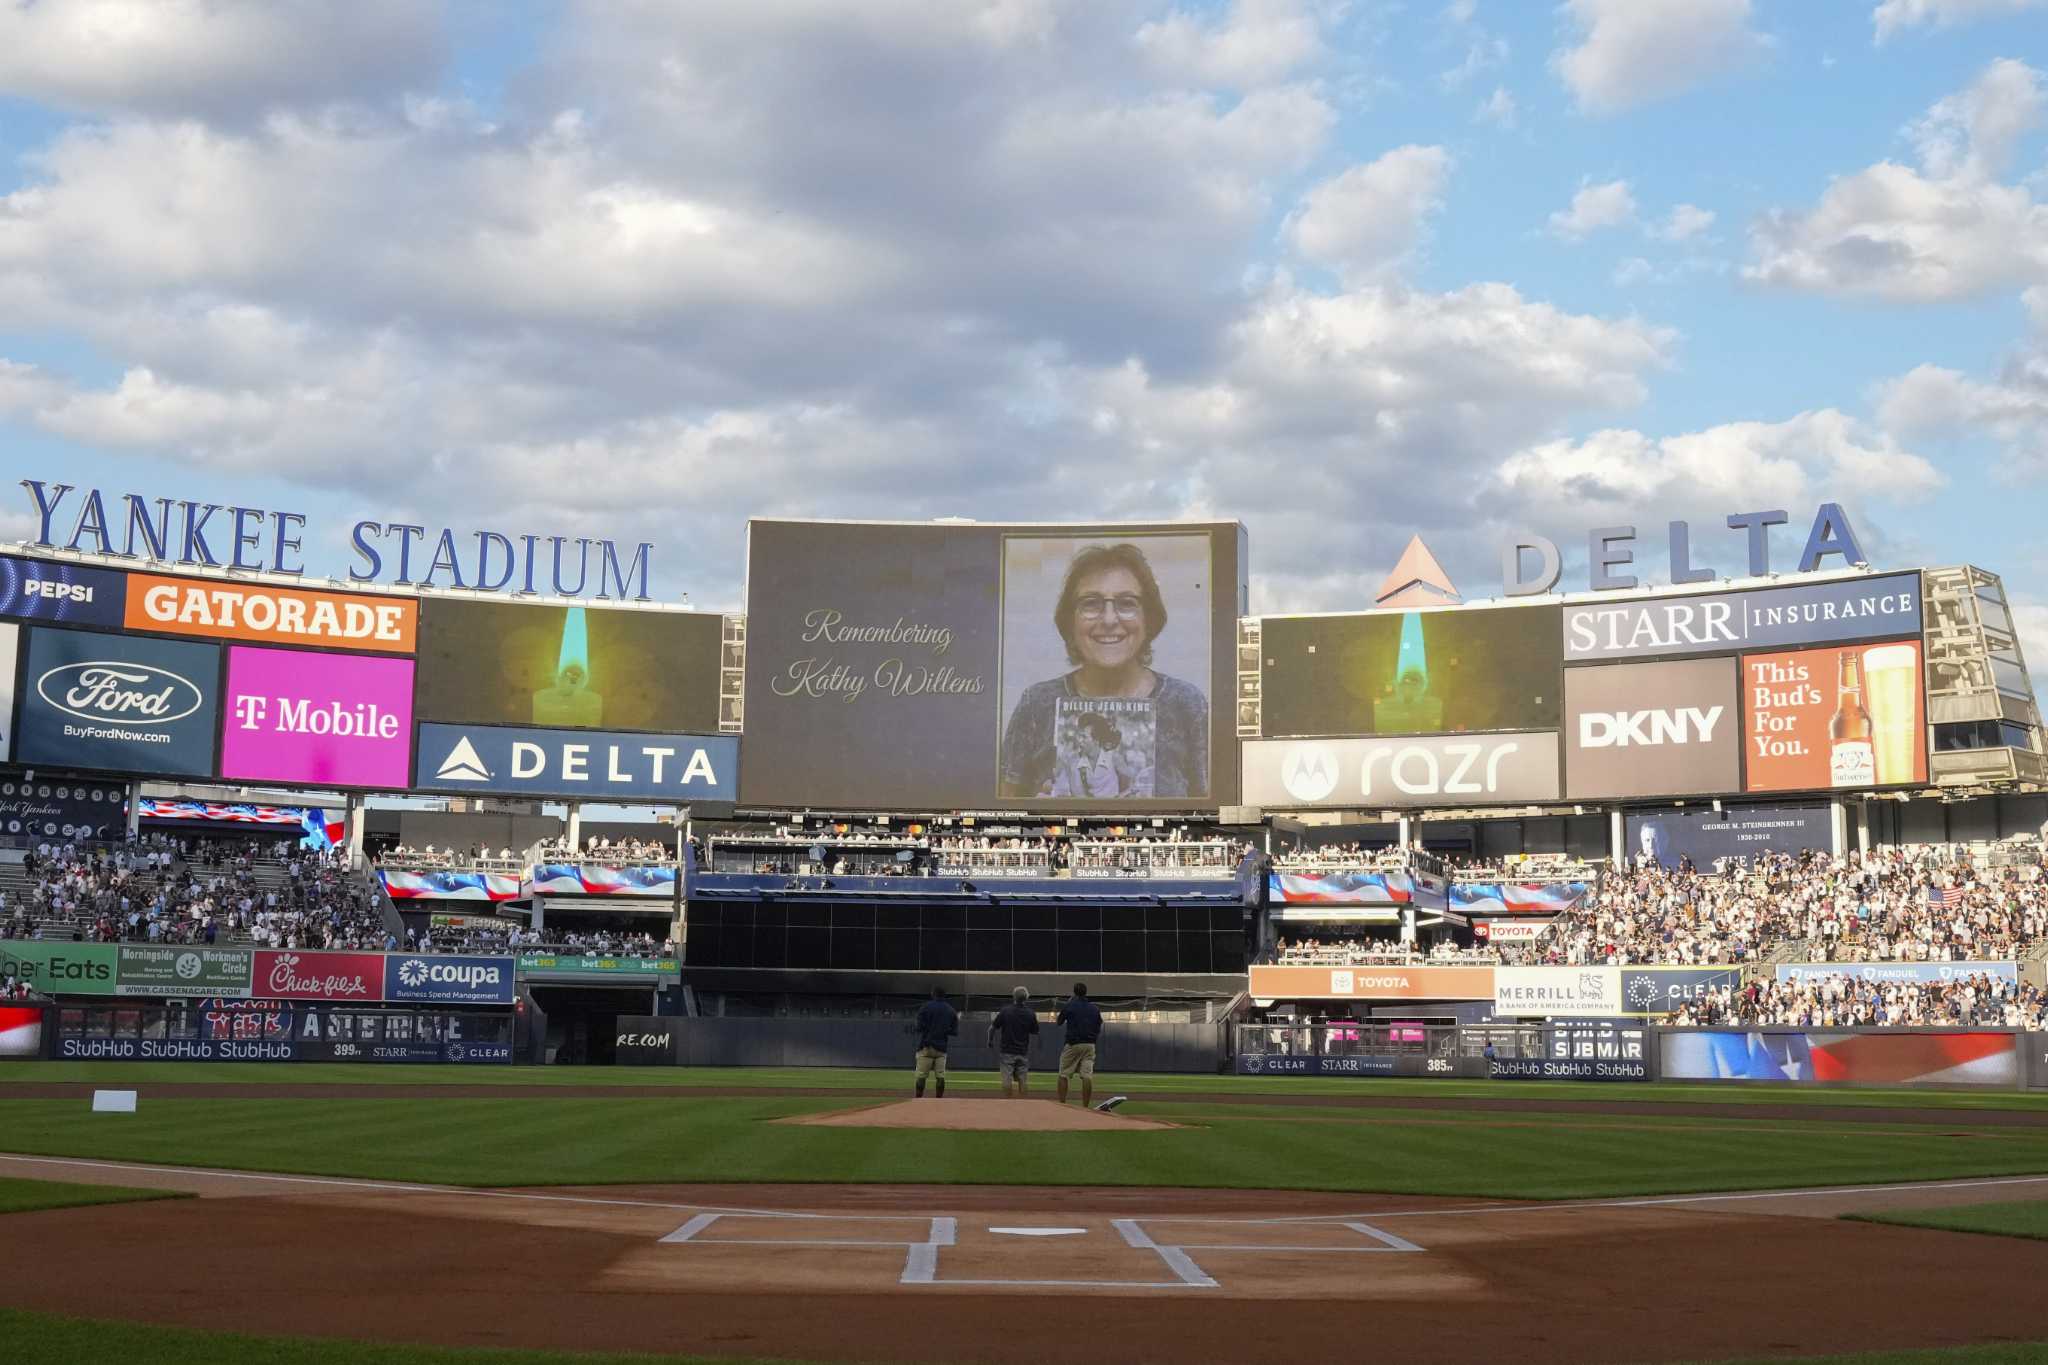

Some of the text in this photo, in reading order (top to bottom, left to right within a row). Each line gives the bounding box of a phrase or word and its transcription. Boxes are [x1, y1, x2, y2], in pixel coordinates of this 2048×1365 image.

[20, 478, 654, 601] YANKEE STADIUM
[1503, 502, 1868, 598] DELTA
[24, 578, 93, 602] PEPSI
[144, 584, 402, 641] GATORADE
[1569, 593, 1913, 651] STARR INSURANCE
[802, 608, 954, 654] Remembering
[771, 656, 985, 703] Kathy Willens
[1752, 660, 1810, 685] This
[66, 668, 175, 716] Ford
[1753, 684, 1822, 708] Bud's
[275, 698, 399, 739] Mobile
[1579, 705, 1724, 748] DKNY
[1754, 711, 1797, 733] For
[63, 724, 171, 743] BuyFordNow.com
[1754, 736, 1809, 757] You.
[511, 741, 717, 785] DELTA
[1361, 742, 1518, 796] razr
[1702, 823, 1730, 831] GEORGE
[1742, 820, 1795, 829] STEINBRENNER
[937, 867, 969, 877] StubHub
[1006, 868, 1038, 877] StubHub
[1076, 869, 1109, 878] StubHub
[1491, 927, 1534, 936] TOYOTA
[2, 951, 110, 979] ber Eats
[122, 948, 174, 962] Morningside
[521, 957, 556, 968] bet365
[581, 958, 616, 969] bet365
[641, 960, 675, 970] bet365
[222, 962, 247, 974] Circle
[431, 964, 500, 988] coupa
[1877, 969, 1920, 979] FANDUEL
[269, 962, 367, 996] Chick-fil-A
[1357, 976, 1410, 988] TOYOTA
[125, 986, 240, 996] WWW.CASSENACARE.COM
[397, 990, 499, 1000] Business Spend Management
[1499, 987, 1575, 999] MERRILL
[1576, 1002, 1615, 1010] COMPANY
[63, 1039, 291, 1059] StubHub StubHub StubHub
[616, 1032, 670, 1049] RE.COM
[373, 1047, 408, 1058] STARR
[470, 1048, 509, 1058] CLEAR
[1268, 1060, 1305, 1070] CLEAR
[1321, 1059, 1359, 1071] STARR
[1491, 1062, 1644, 1077] StubHub StubHub StubHub
